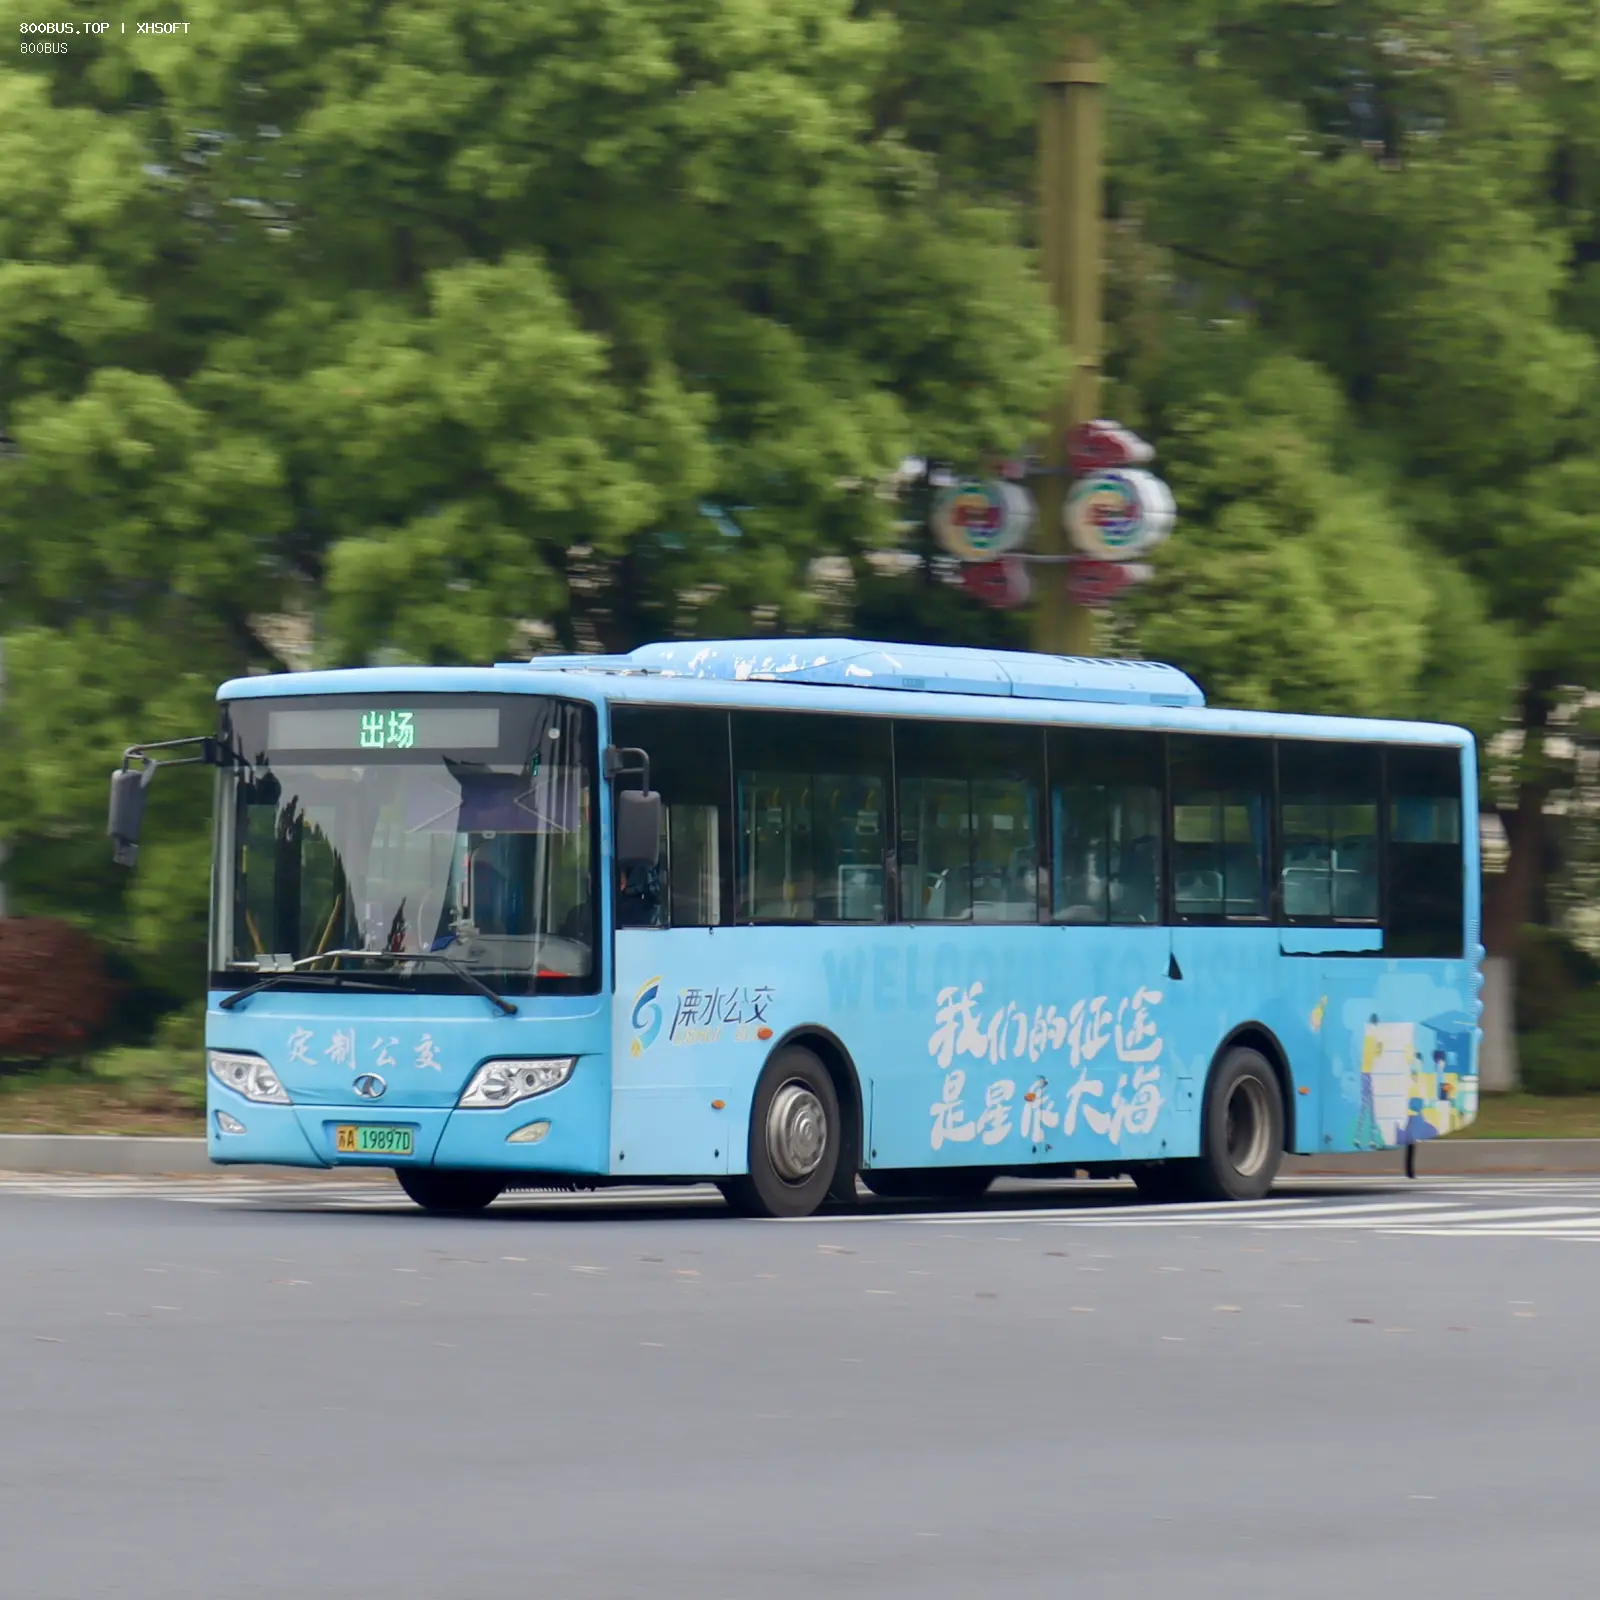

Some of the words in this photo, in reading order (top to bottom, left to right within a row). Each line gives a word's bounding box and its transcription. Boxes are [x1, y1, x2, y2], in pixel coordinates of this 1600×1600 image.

[360, 711, 415, 749] 出场
[669, 985, 776, 1041] 溧水公交
[928, 980, 1165, 1069] 我们的征途
[286, 1027, 443, 1073] 定制公交
[929, 1063, 1166, 1152] 是星辰大海
